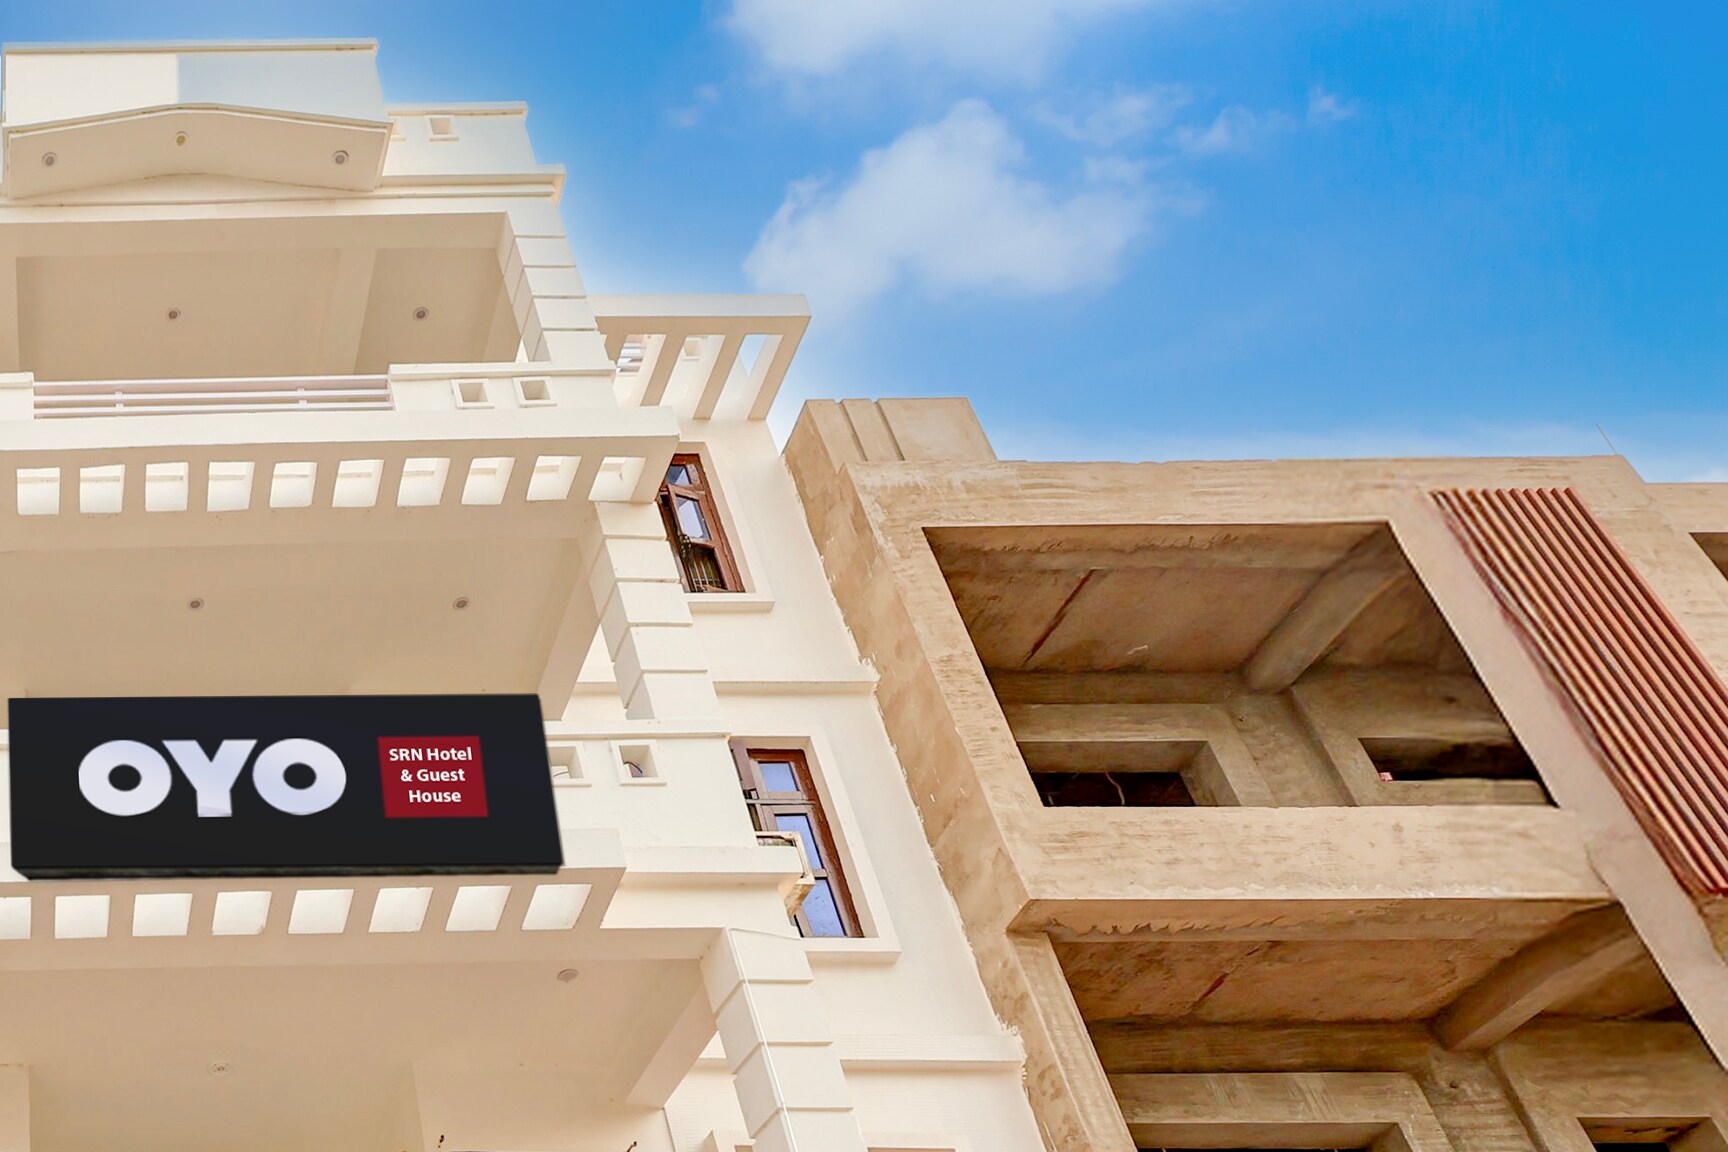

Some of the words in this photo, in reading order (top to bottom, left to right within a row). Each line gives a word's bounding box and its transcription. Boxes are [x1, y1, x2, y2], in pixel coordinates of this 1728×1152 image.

[389, 748, 423, 761] SRN
[426, 746, 473, 761] Hotel
[78, 738, 347, 817] OYO
[400, 769, 413, 782] &
[416, 768, 466, 782] Guest
[408, 789, 462, 803] House
